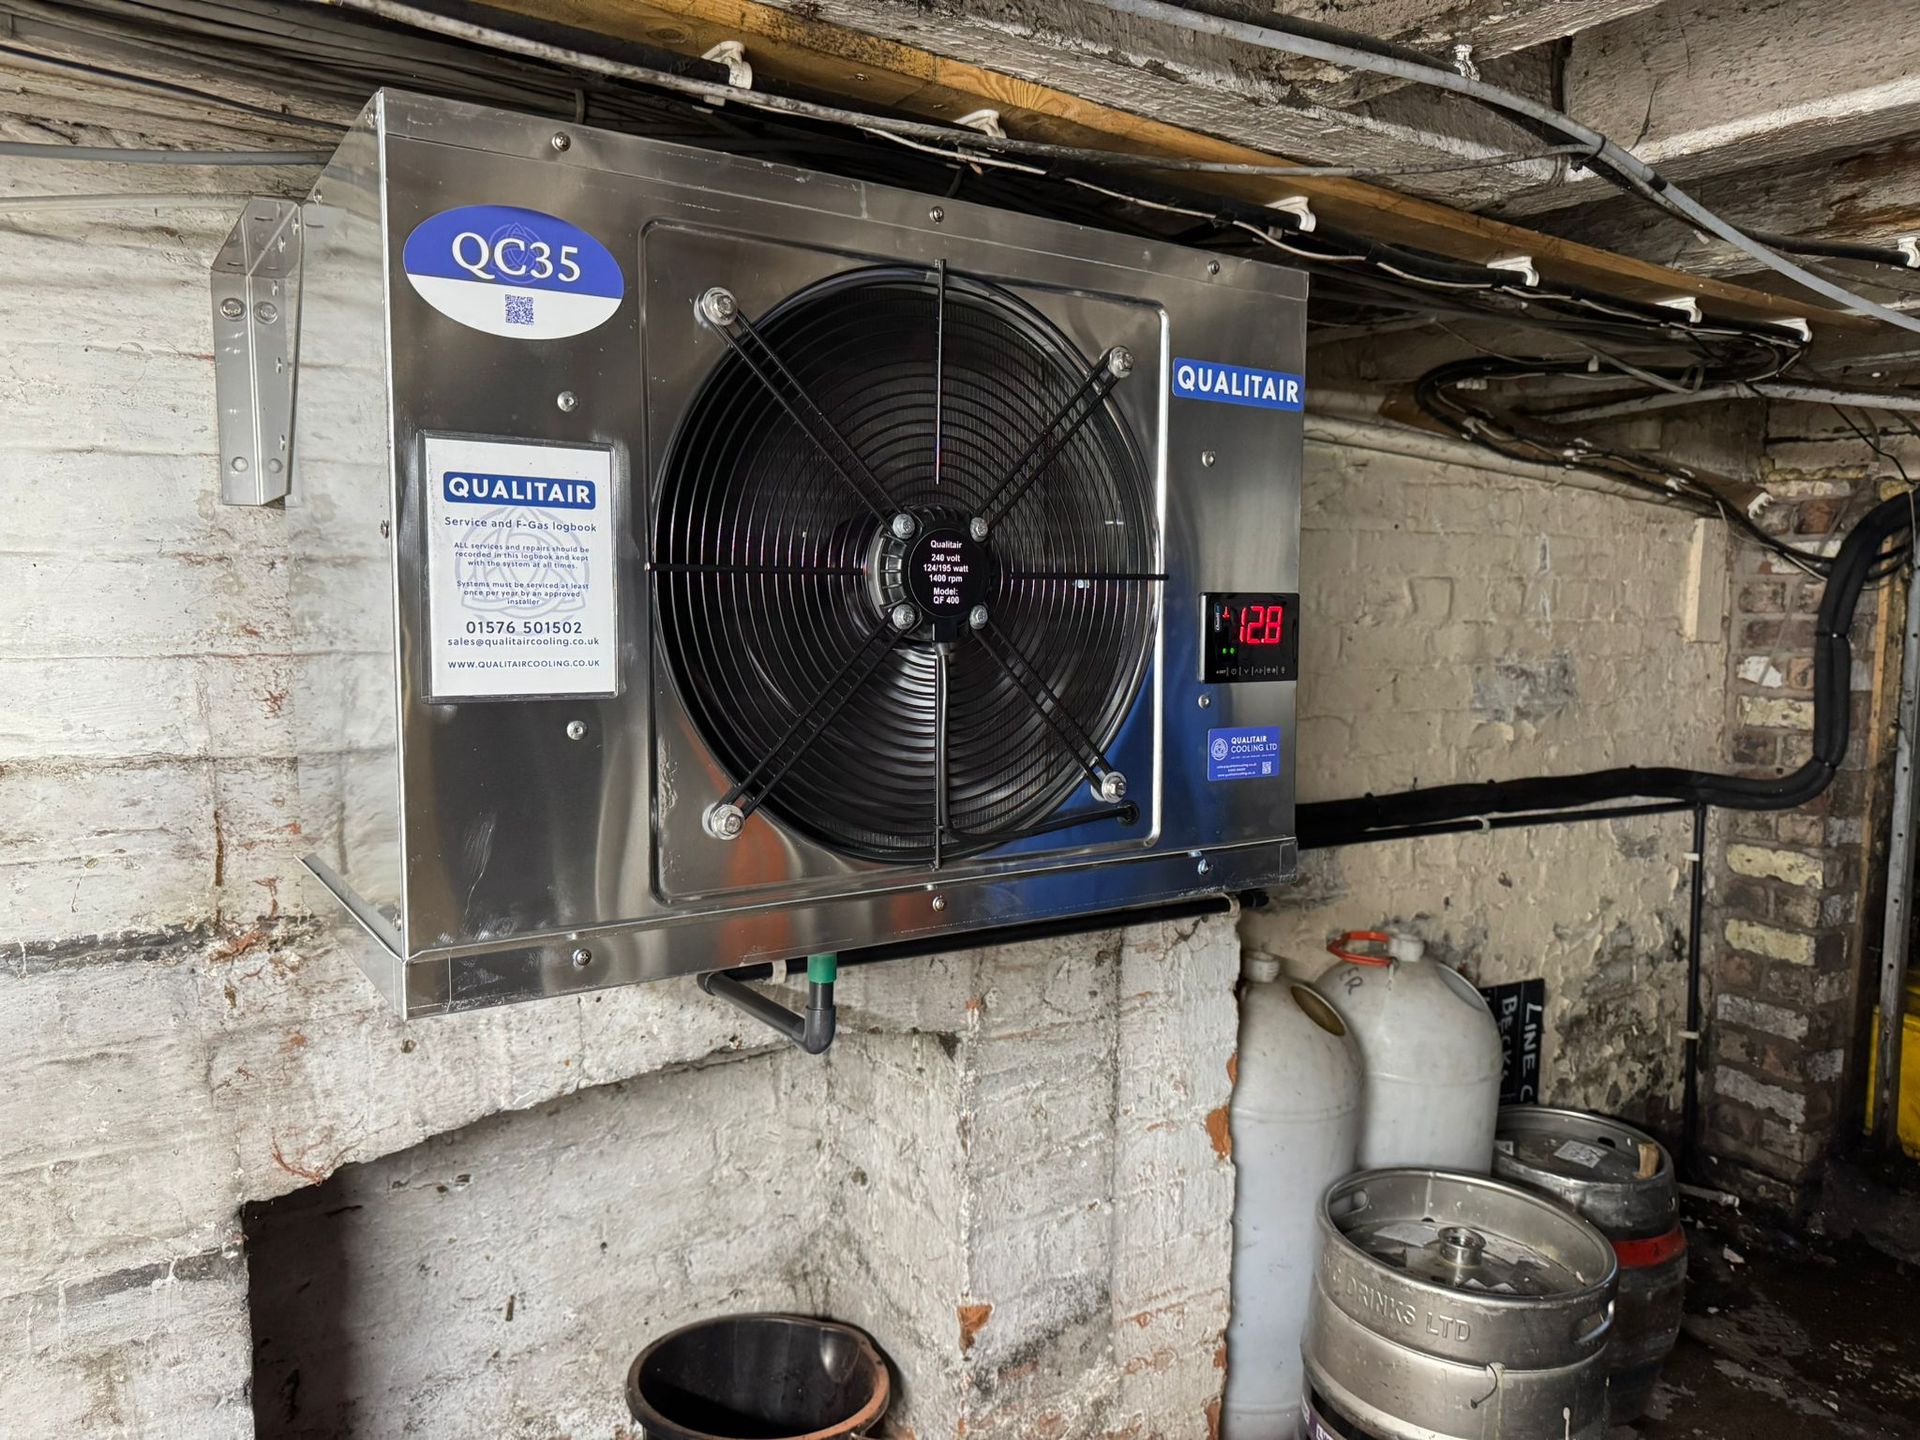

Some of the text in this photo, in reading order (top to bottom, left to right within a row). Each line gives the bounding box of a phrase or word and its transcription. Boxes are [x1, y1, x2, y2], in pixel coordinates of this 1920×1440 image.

[452, 232, 581, 282] QC35
[1177, 365, 1299, 403] QUALITAIR
[449, 477, 591, 503] QUALITAIR
[445, 517, 597, 533] Service and F-Gas logbook
[505, 543, 520, 551] and
[552, 545, 578, 553] should
[930, 540, 962, 549] Qualitair
[521, 553, 553, 561] logbook
[572, 555, 589, 563] kept
[931, 554, 961, 562] 240 volt
[502, 561, 531, 569] system
[923, 563, 969, 573] 124/195 watt
[929, 574, 963, 583] 1400 rpm
[571, 582, 589, 590] least
[485, 590, 499, 598] per
[501, 590, 519, 598] year
[521, 590, 531, 598] by
[933, 587, 958, 596] Model:
[933, 596, 960, 605] QF 400
[466, 621, 583, 634] 01576 501502
[1239, 605, 1283, 644] 12.8
[447, 637, 599, 648] sales@qualitaircooling.co.uk
[448, 660, 600, 669] WWW.QUALITAIRCOOLING.CO.UK
[1231, 736, 1267, 744] QUALITAIR
[1231, 743, 1278, 753] COOLING LTD
[1520, 1003, 1543, 1104] LINE C
[1346, 1277, 1471, 1342] DRINKS LTD
